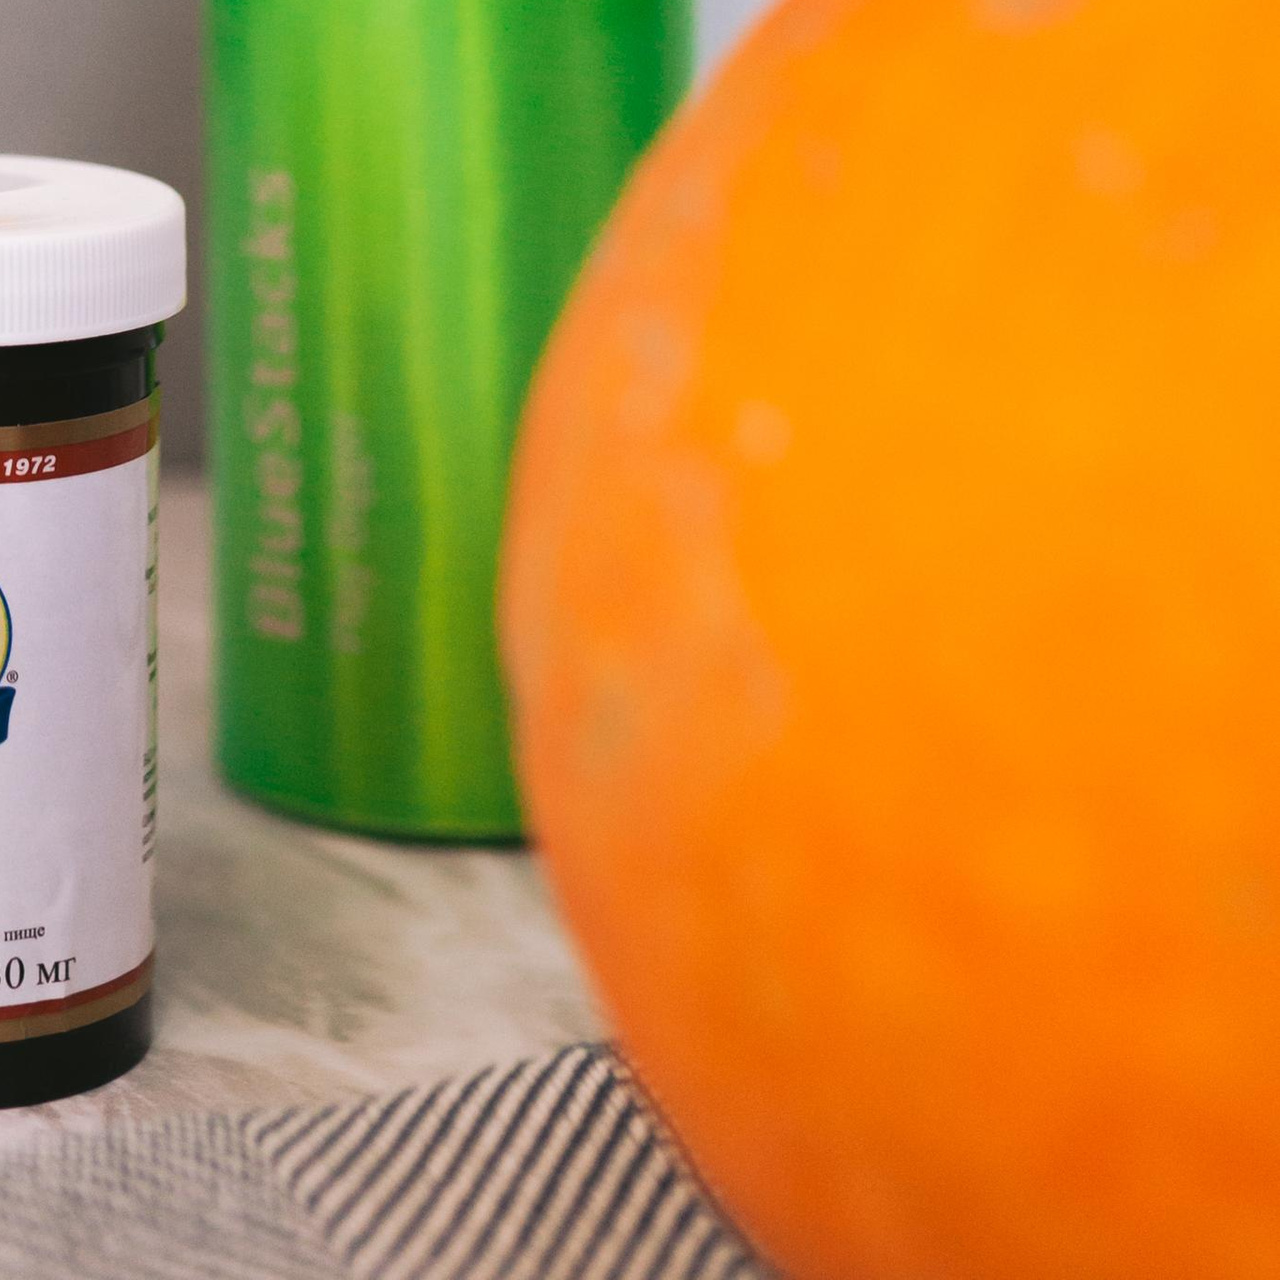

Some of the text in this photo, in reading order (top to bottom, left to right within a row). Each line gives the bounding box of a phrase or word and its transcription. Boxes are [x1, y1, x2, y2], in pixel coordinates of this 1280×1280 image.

[3, 454, 57, 477] 1972
[3, 923, 46, 944] пище
[36, 956, 77, 986] мг
